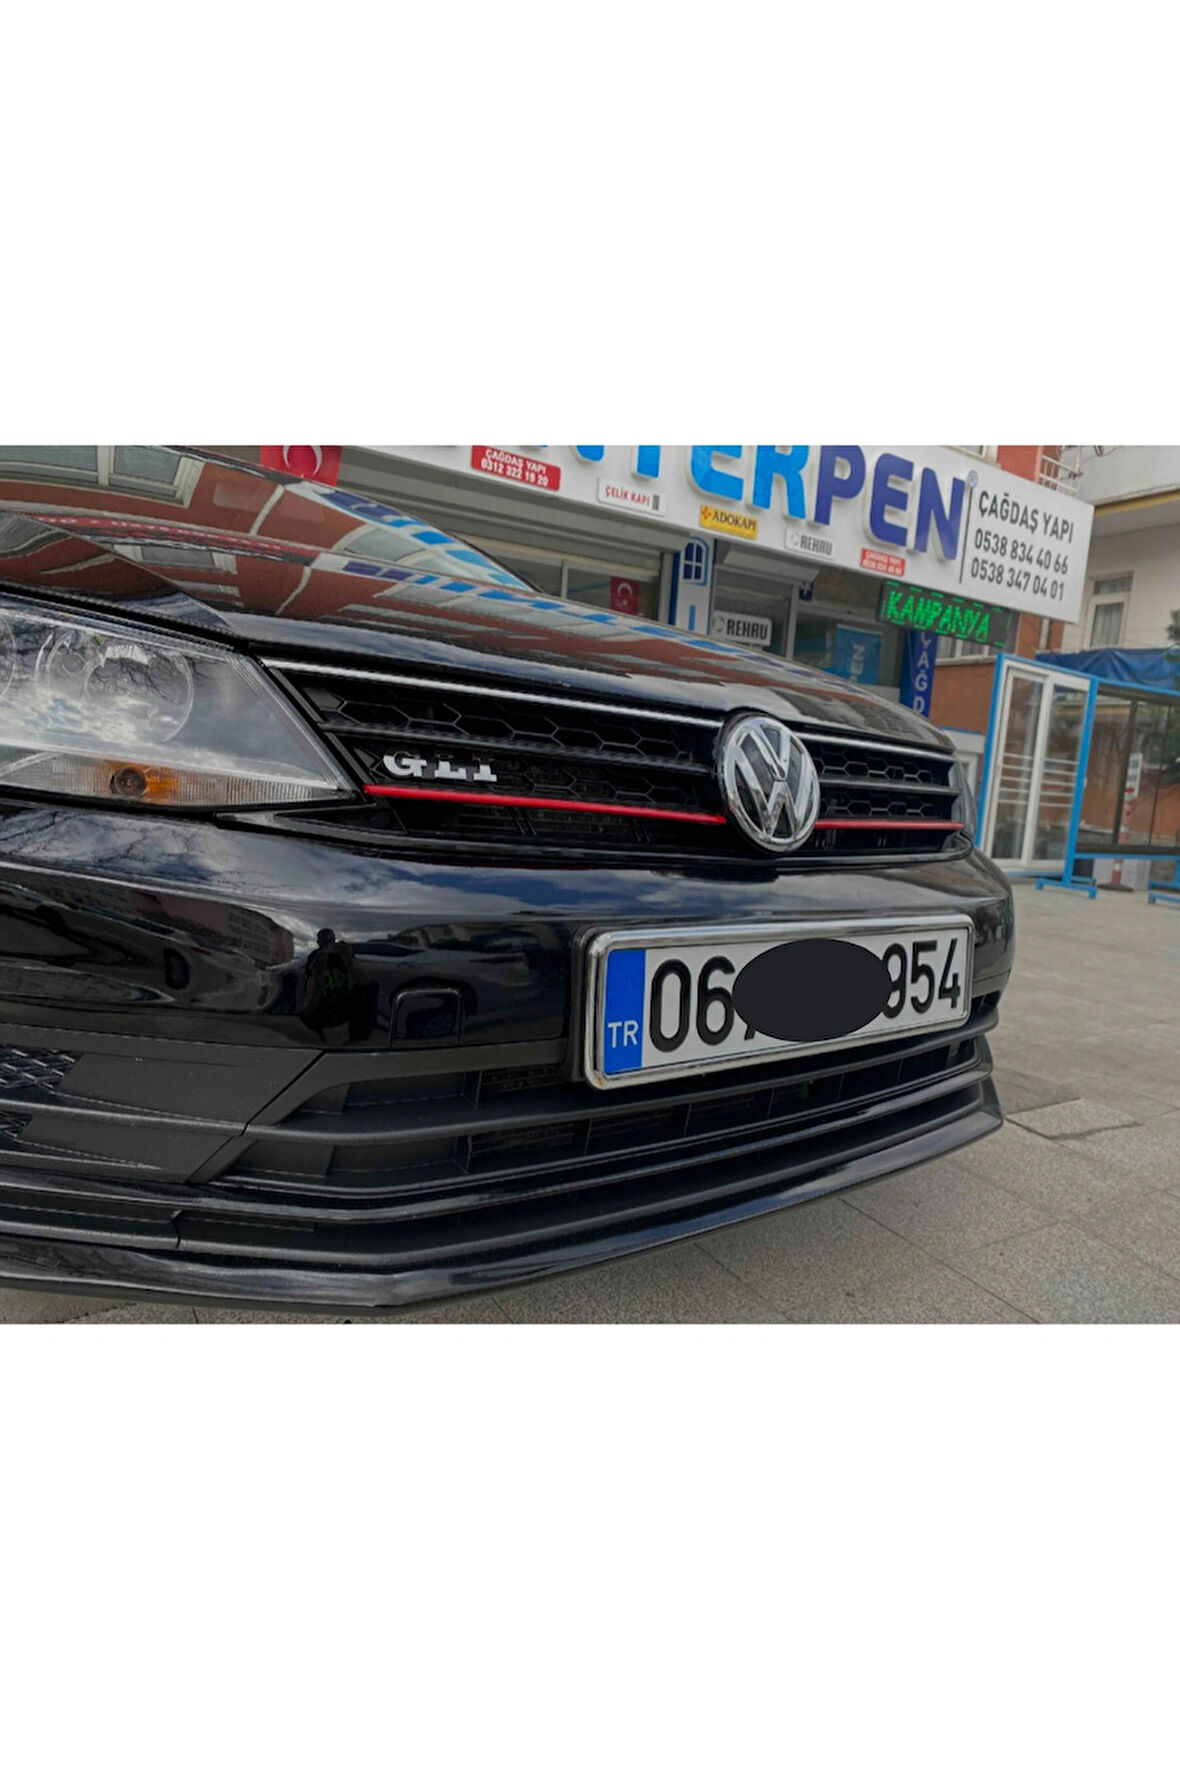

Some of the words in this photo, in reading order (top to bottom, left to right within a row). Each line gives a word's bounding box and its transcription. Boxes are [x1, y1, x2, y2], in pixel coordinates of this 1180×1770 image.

[481, 457, 504, 474] 0312
[506, 465, 522, 479] 322
[525, 470, 536, 483] 19
[537, 474, 549, 487] 20
[526, 460, 546, 474] YAPI
[631, 492, 650, 506] KAPI
[712, 510, 756, 532] ADOKAPI
[979, 490, 1039, 534] ÇAĞDAŞ
[1043, 511, 1074, 543] YAPI
[800, 534, 833, 556] REHAU
[974, 528, 1008, 557] 0538
[1010, 539, 1034, 565] 834
[1036, 548, 1052, 570] 40
[1054, 553, 1069, 575] 66
[971, 557, 1005, 585] 0538
[1006, 567, 1031, 592] 347
[1033, 575, 1048, 597] 04
[1050, 580, 1064, 602] 01
[726, 619, 768, 640] REHAU
[886, 590, 990, 641] KAMPANYA
[649, 955, 735, 1052] 06
[607, 1020, 640, 1049] TR
